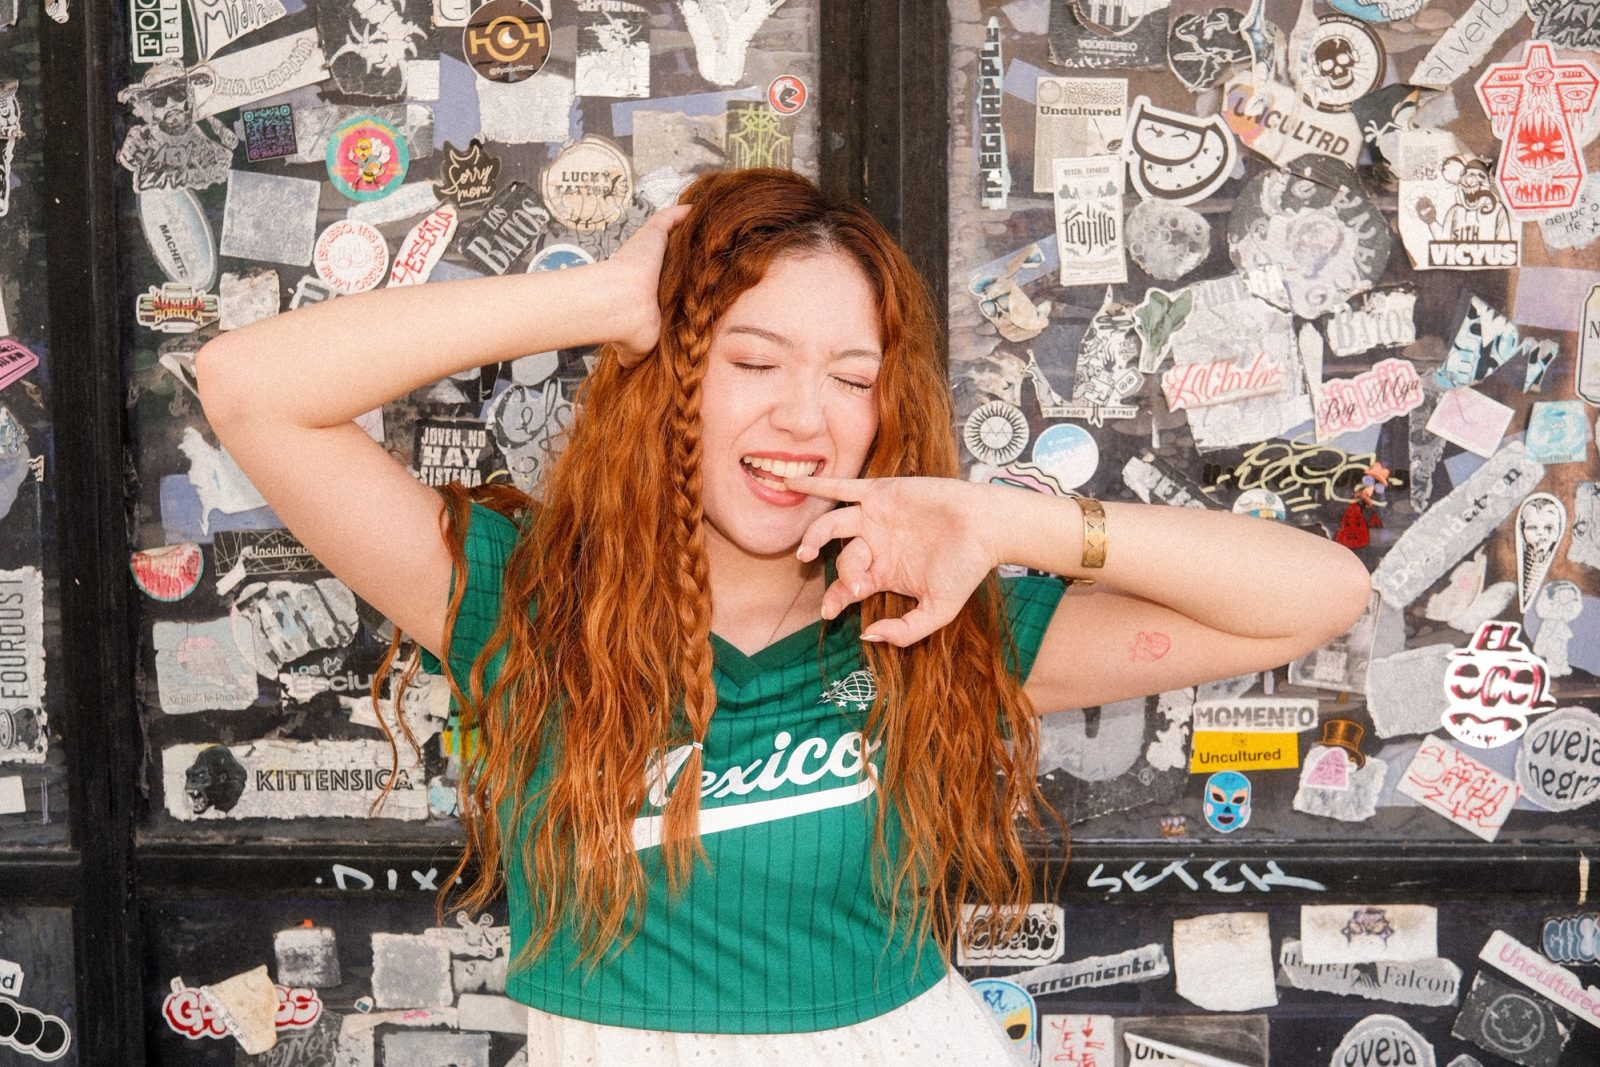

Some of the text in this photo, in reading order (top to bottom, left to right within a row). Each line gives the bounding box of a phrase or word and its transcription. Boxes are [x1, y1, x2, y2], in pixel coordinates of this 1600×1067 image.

[1040, 105, 1121, 117] Uncultured
[562, 171, 610, 183] LUCKY
[483, 204, 507, 230] LOS
[467, 198, 550, 275] BATOS
[159, 224, 187, 278] MACHETE
[1430, 243, 1517, 266] VICYUS
[422, 446, 481, 468] HAY
[419, 467, 481, 488] SISTEMA
[290, 664, 320, 677] LOS
[1195, 706, 1315, 728] MOMENTO
[1199, 748, 1281, 765] Uncultured
[1383, 966, 1456, 994] Falcon
[1344, 1031, 1416, 1067] oveja
